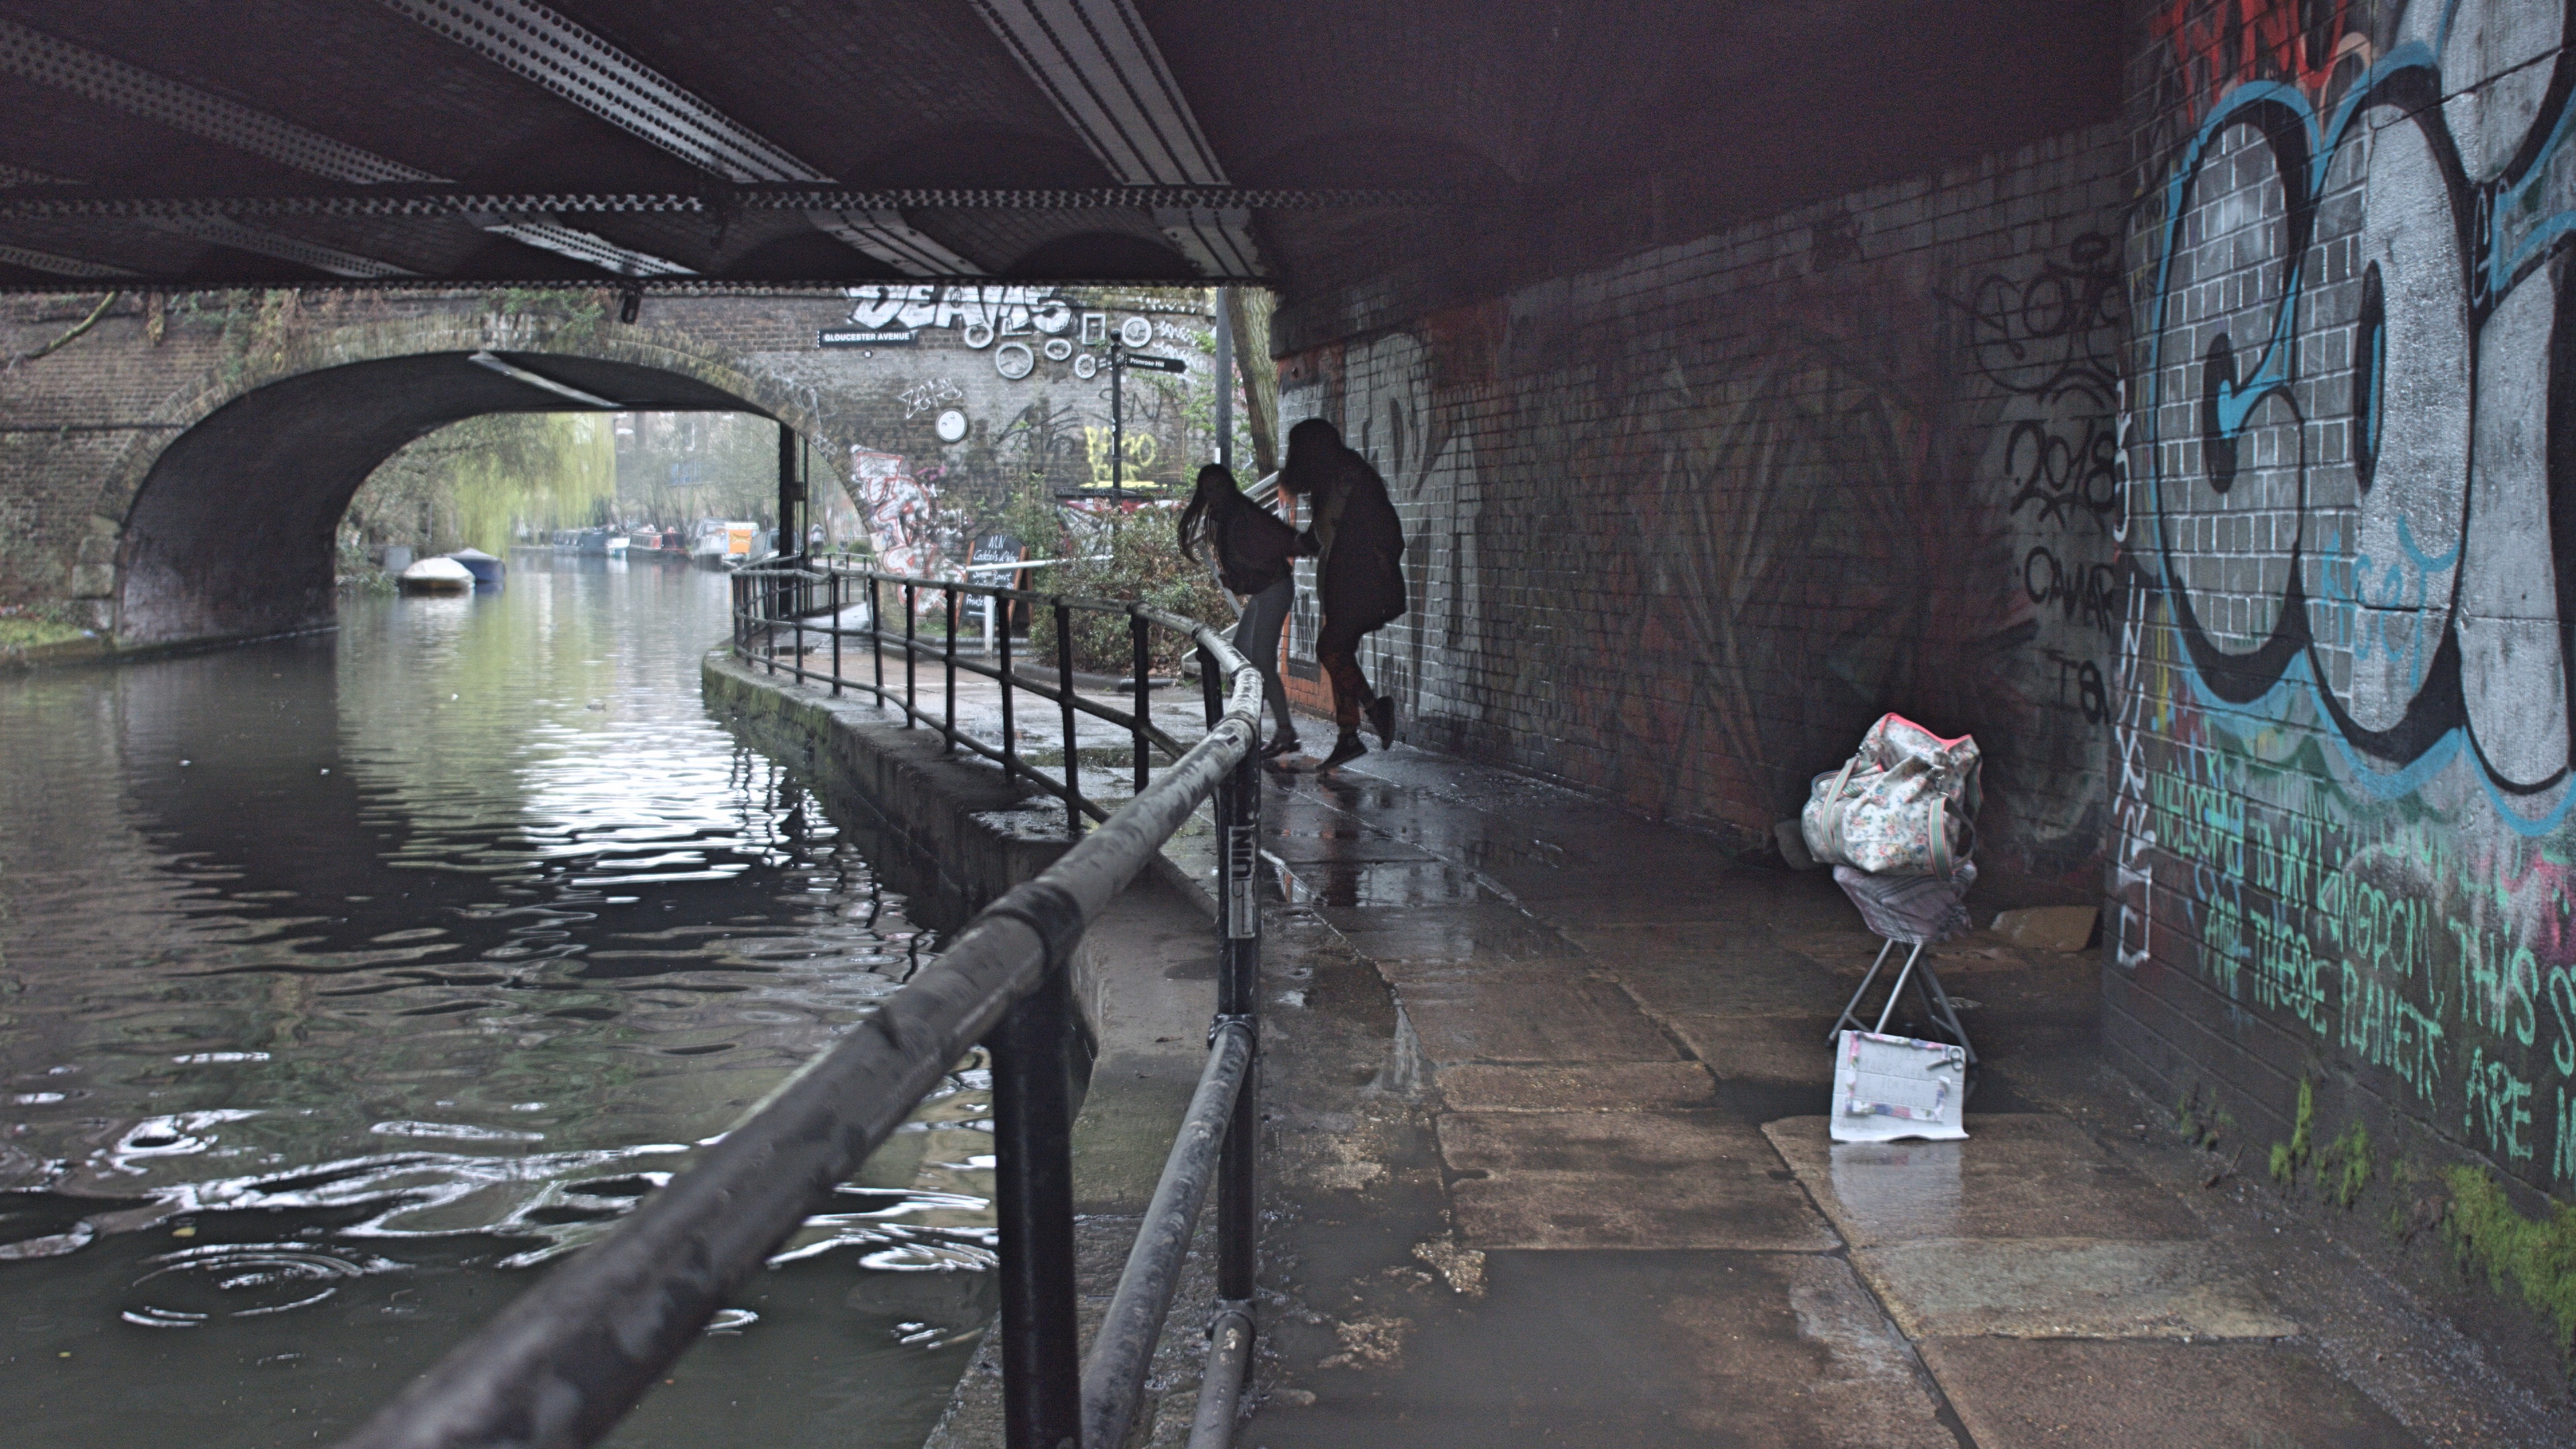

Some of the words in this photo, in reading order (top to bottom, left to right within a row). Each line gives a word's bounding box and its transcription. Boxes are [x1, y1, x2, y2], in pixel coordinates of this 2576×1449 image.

[824, 333, 876, 342] GLOUCESTER
[877, 332, 910, 341] AVENUE
[1130, 358, 1155, 366] Primrose
[1155, 360, 1165, 368] Hill
[2463, 1045, 2534, 1163] ARE
